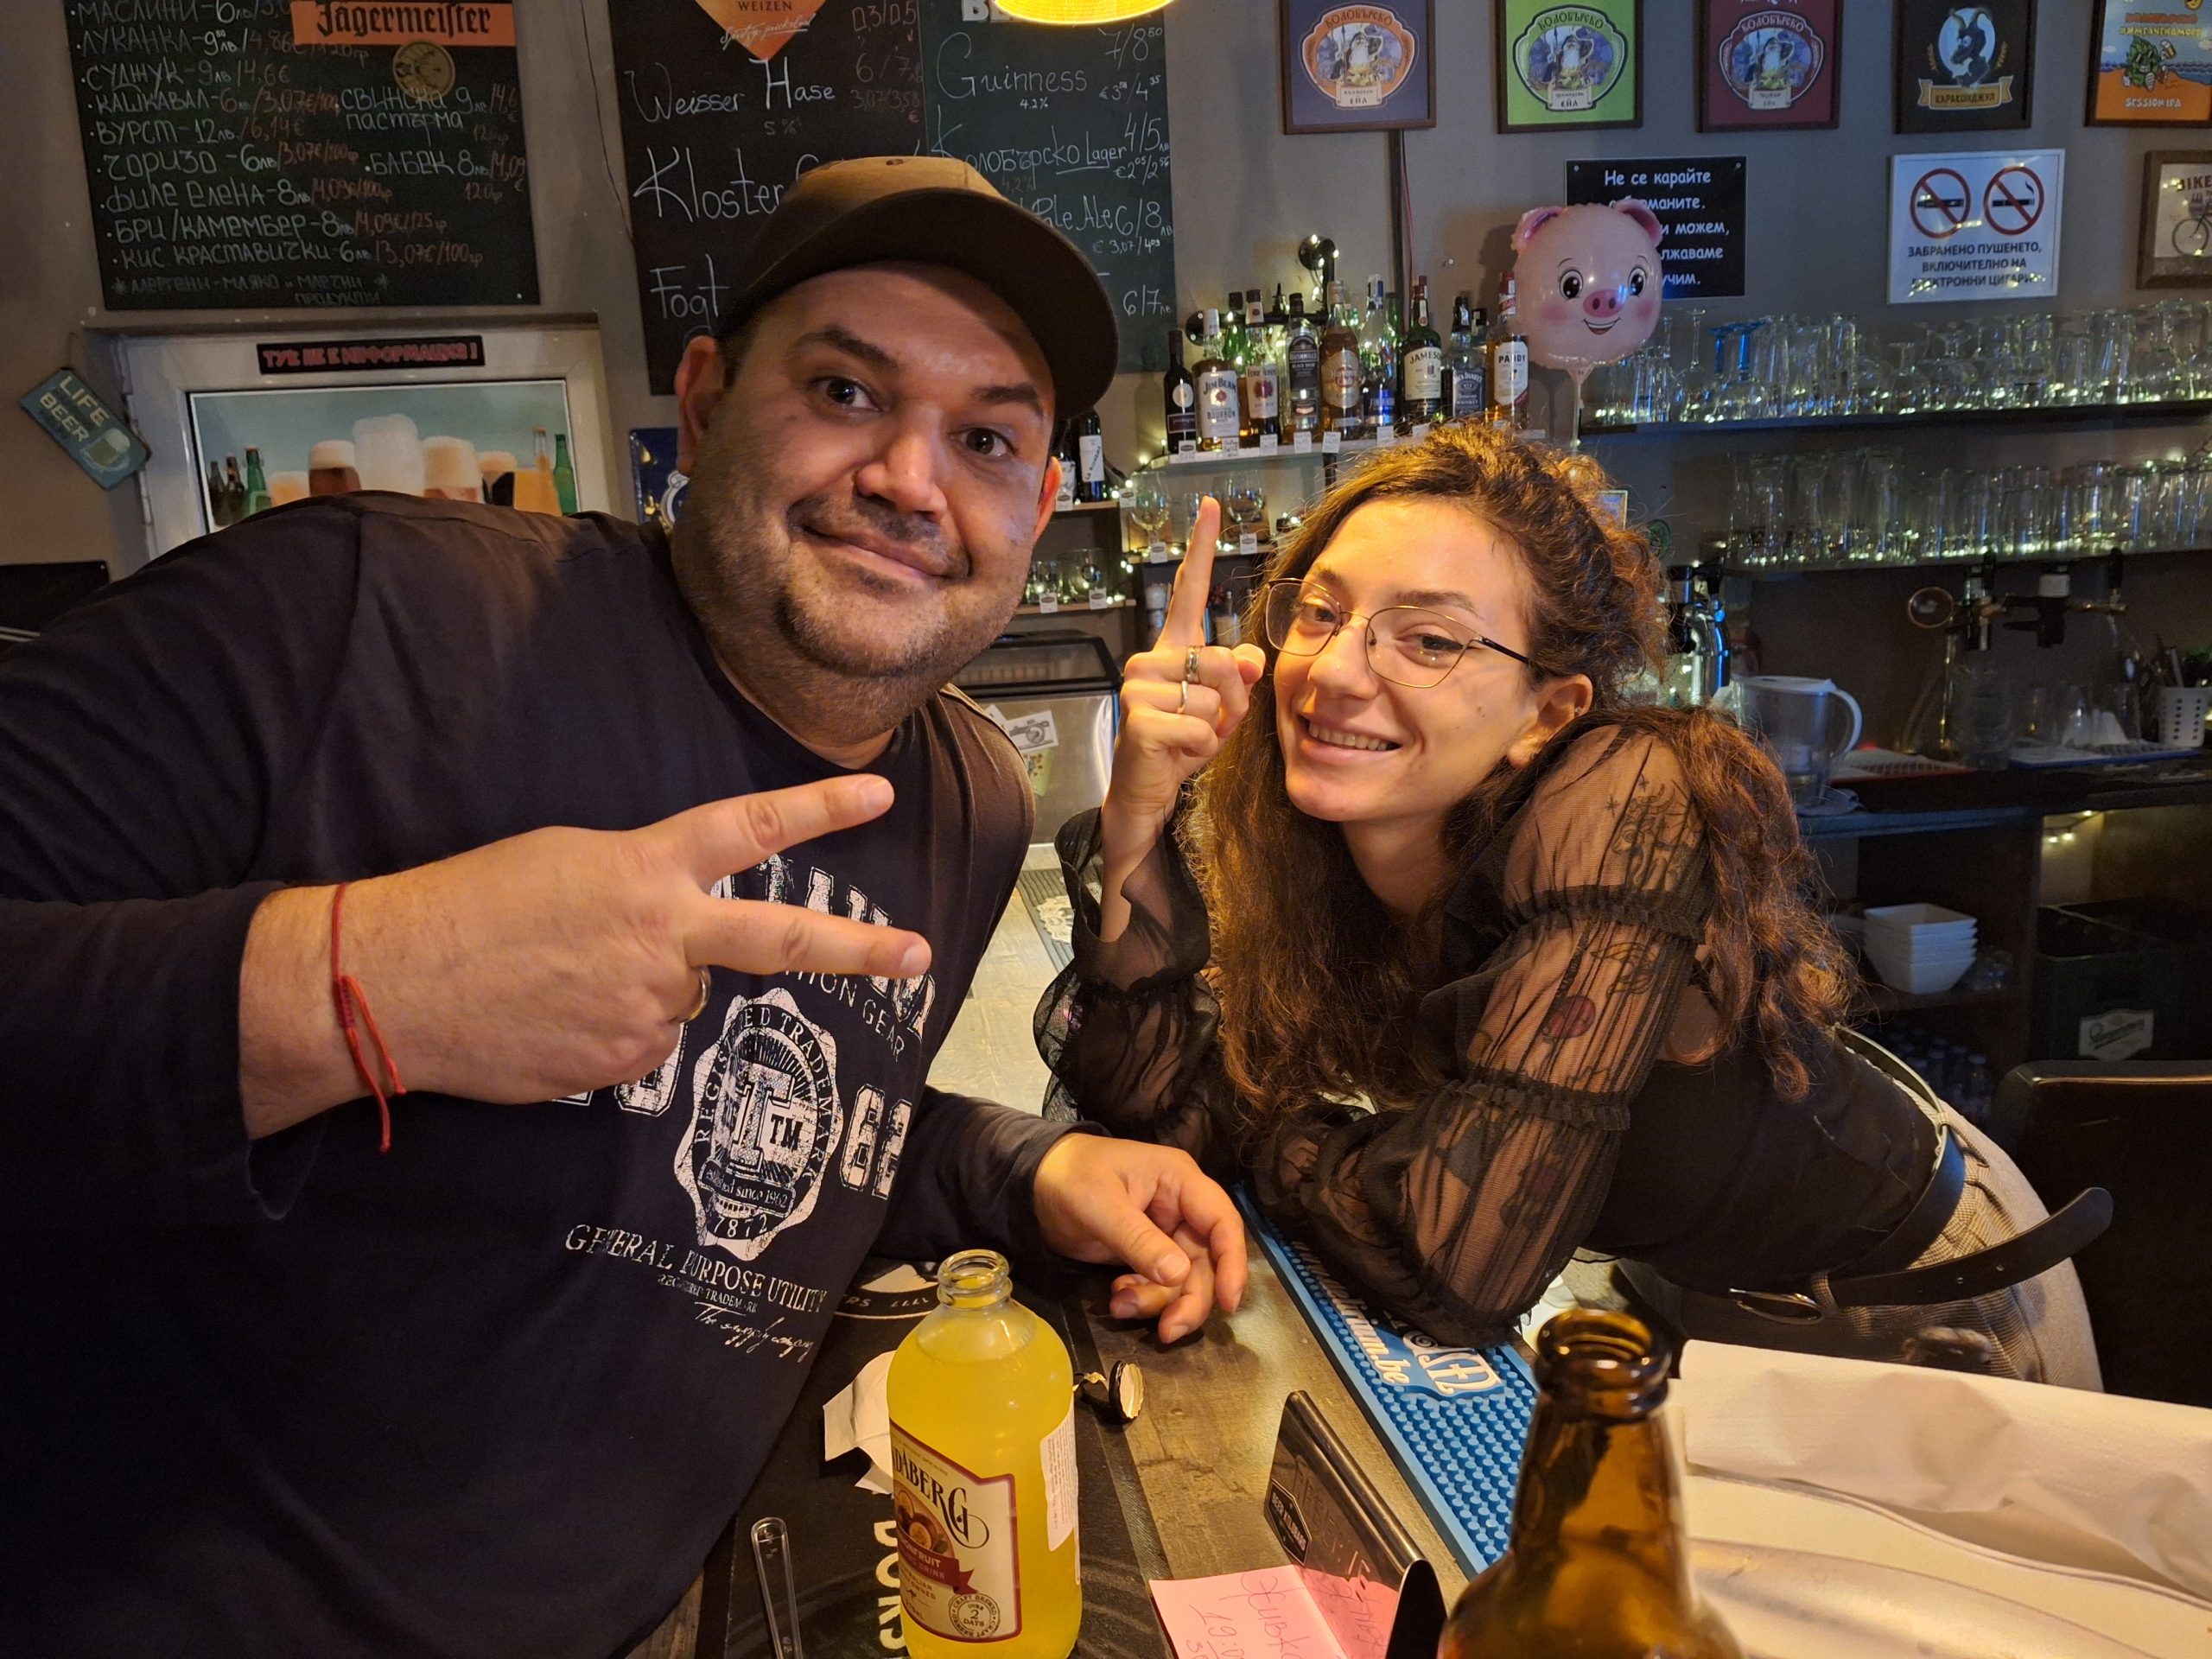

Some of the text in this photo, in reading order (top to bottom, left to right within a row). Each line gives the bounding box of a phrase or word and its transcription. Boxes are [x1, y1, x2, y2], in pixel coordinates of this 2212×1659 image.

[738, 0, 793, 12] WEIZEN
[936, 31, 1089, 99] Guinness
[748, 55, 836, 111] Hase
[2125, 97, 2183, 108] SESSION IPA
[1085, 130, 1128, 169] Lager
[632, 145, 790, 224] Kloster
[1604, 168, 1712, 188] Не се карайте
[1675, 226, 1730, 238] можем,
[1908, 241, 2042, 257] ЗАБРАНЕНО ПУШЕНЕТО,
[1922, 259, 2026, 273] ВКЛЮЧИТЕЛНО НА
[59, 374, 111, 428] LIFE
[39, 391, 90, 443] BEER
[767, 1274, 831, 1315] UTILITY
[963, 1618, 986, 1628] DAYS
[969, 1608, 981, 1621] 2
